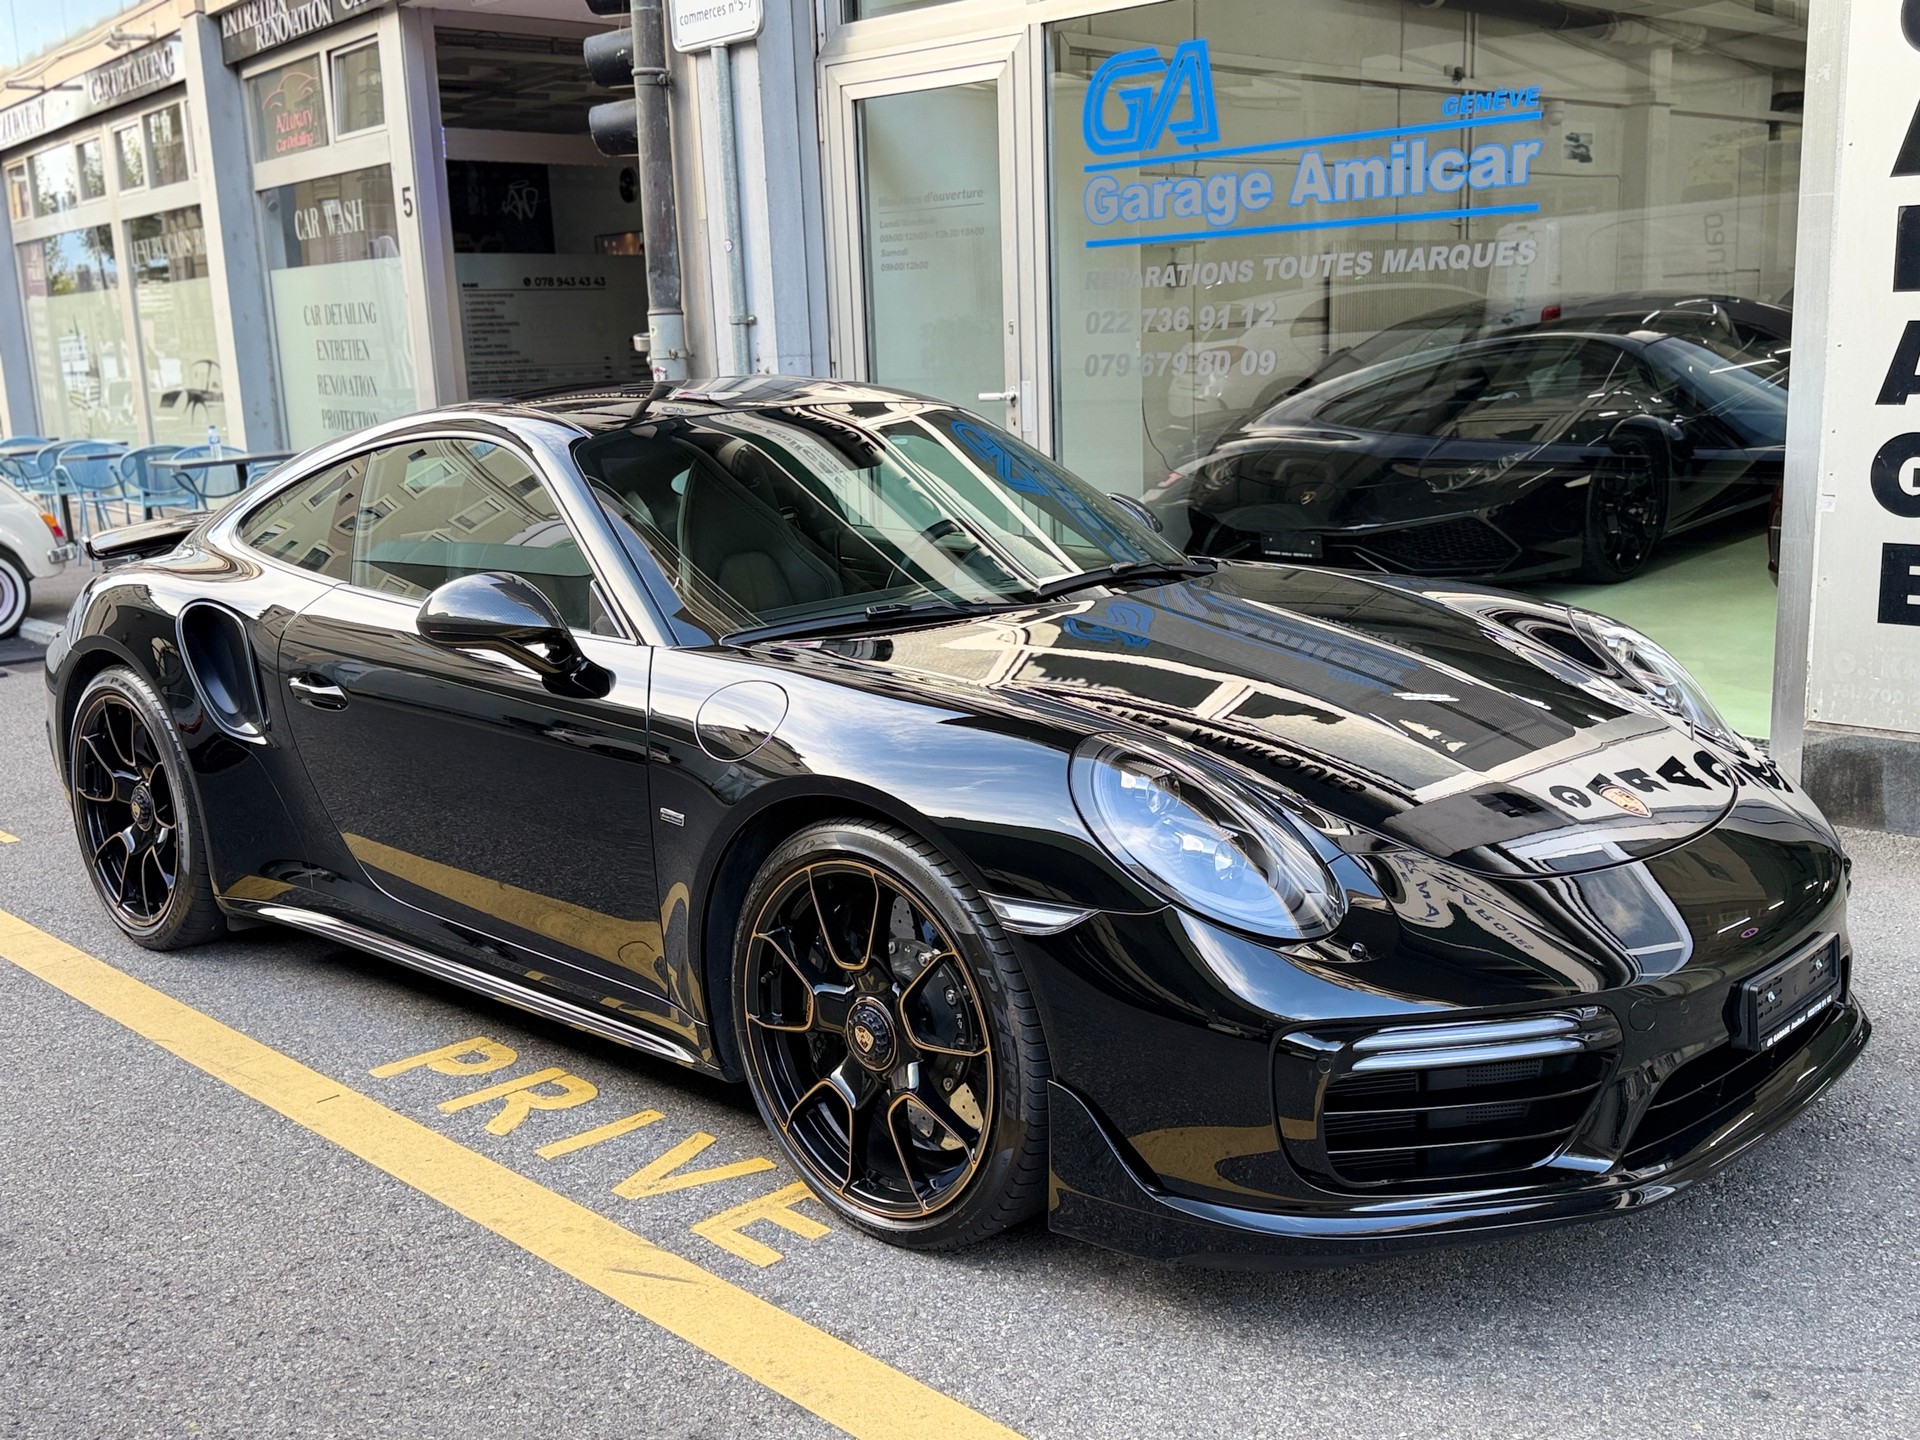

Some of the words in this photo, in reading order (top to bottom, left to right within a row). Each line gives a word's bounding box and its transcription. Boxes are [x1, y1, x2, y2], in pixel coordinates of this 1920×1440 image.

[254, 0, 334, 51] RENOVATION
[679, 4, 726, 26] commerces
[1084, 173, 1273, 227] Garage
[1288, 138, 1543, 206] Amilcar
[402, 186, 413, 218] 5
[295, 207, 320, 240] CAR
[322, 198, 365, 236] WASH
[1263, 249, 1372, 281] TOUTES
[1381, 239, 1537, 274] MARQUES
[534, 276, 553, 287] 078
[556, 276, 576, 287] 943
[578, 276, 591, 287] 43
[593, 276, 606, 287] 43
[303, 304, 321, 327] CAR
[324, 301, 377, 326] DETAILING
[1142, 305, 1187, 333] 736
[1199, 303, 1230, 332] 91
[1240, 300, 1276, 329] 12
[316, 338, 370, 361] ENTRETIEN
[1084, 354, 1130, 377] 079
[1141, 353, 1186, 377] 679
[1240, 348, 1276, 375] 09
[317, 374, 378, 398] RENOVATION
